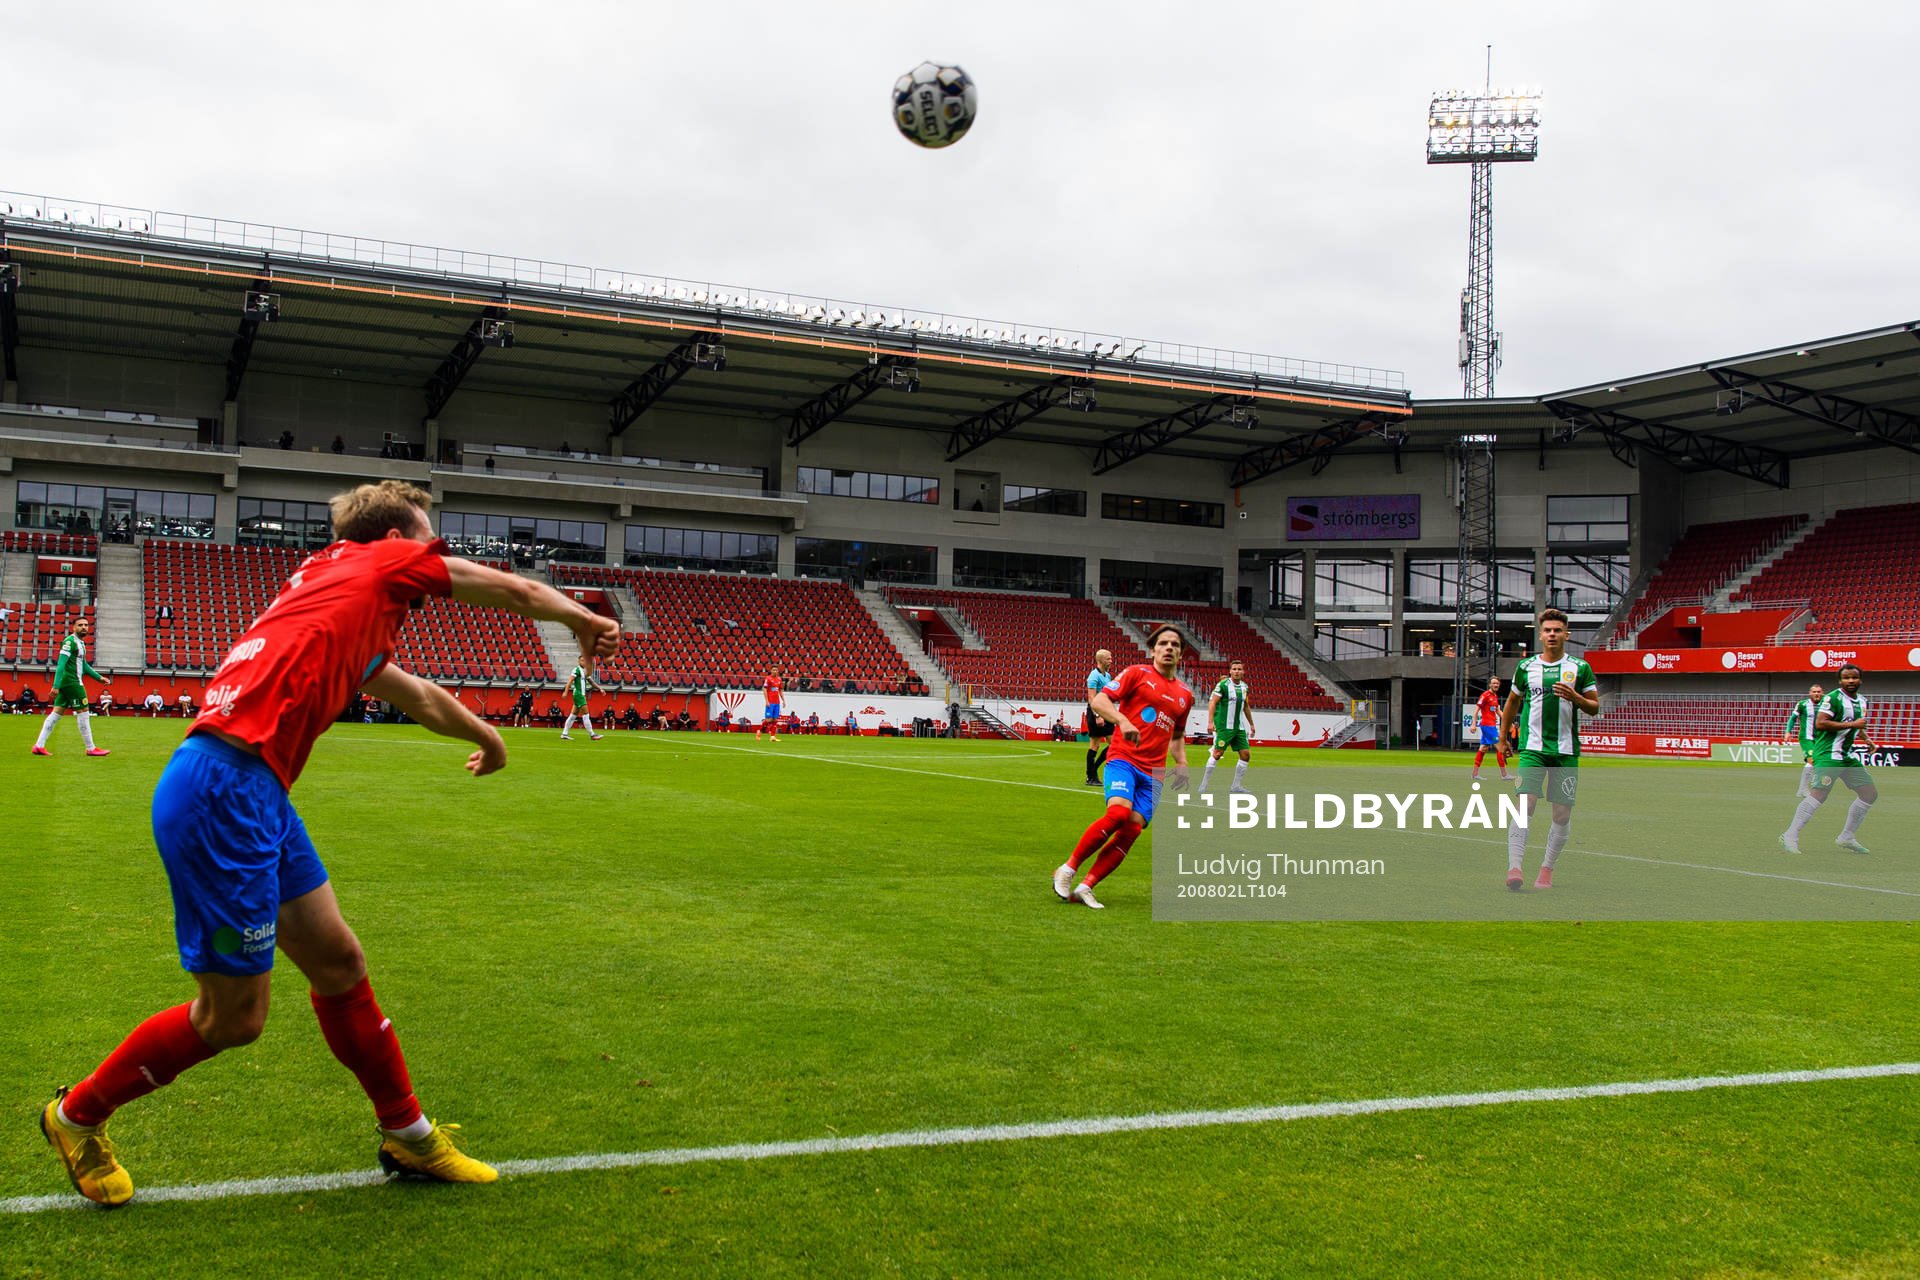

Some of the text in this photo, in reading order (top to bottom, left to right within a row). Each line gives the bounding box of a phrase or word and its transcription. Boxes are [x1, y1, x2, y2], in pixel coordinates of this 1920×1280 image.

[920, 90, 939, 137] SELECT
[1323, 510, 1417, 529] strömbergs
[1656, 653, 1680, 661] Resurs
[1737, 651, 1763, 660] Resurs
[1827, 649, 1857, 659] Resurs
[1656, 661, 1674, 669] Bank
[1737, 660, 1756, 668] Bank
[1583, 735, 1621, 746] PEAB
[1728, 746, 1793, 764] VINGE
[243, 921, 275, 942] Solid
